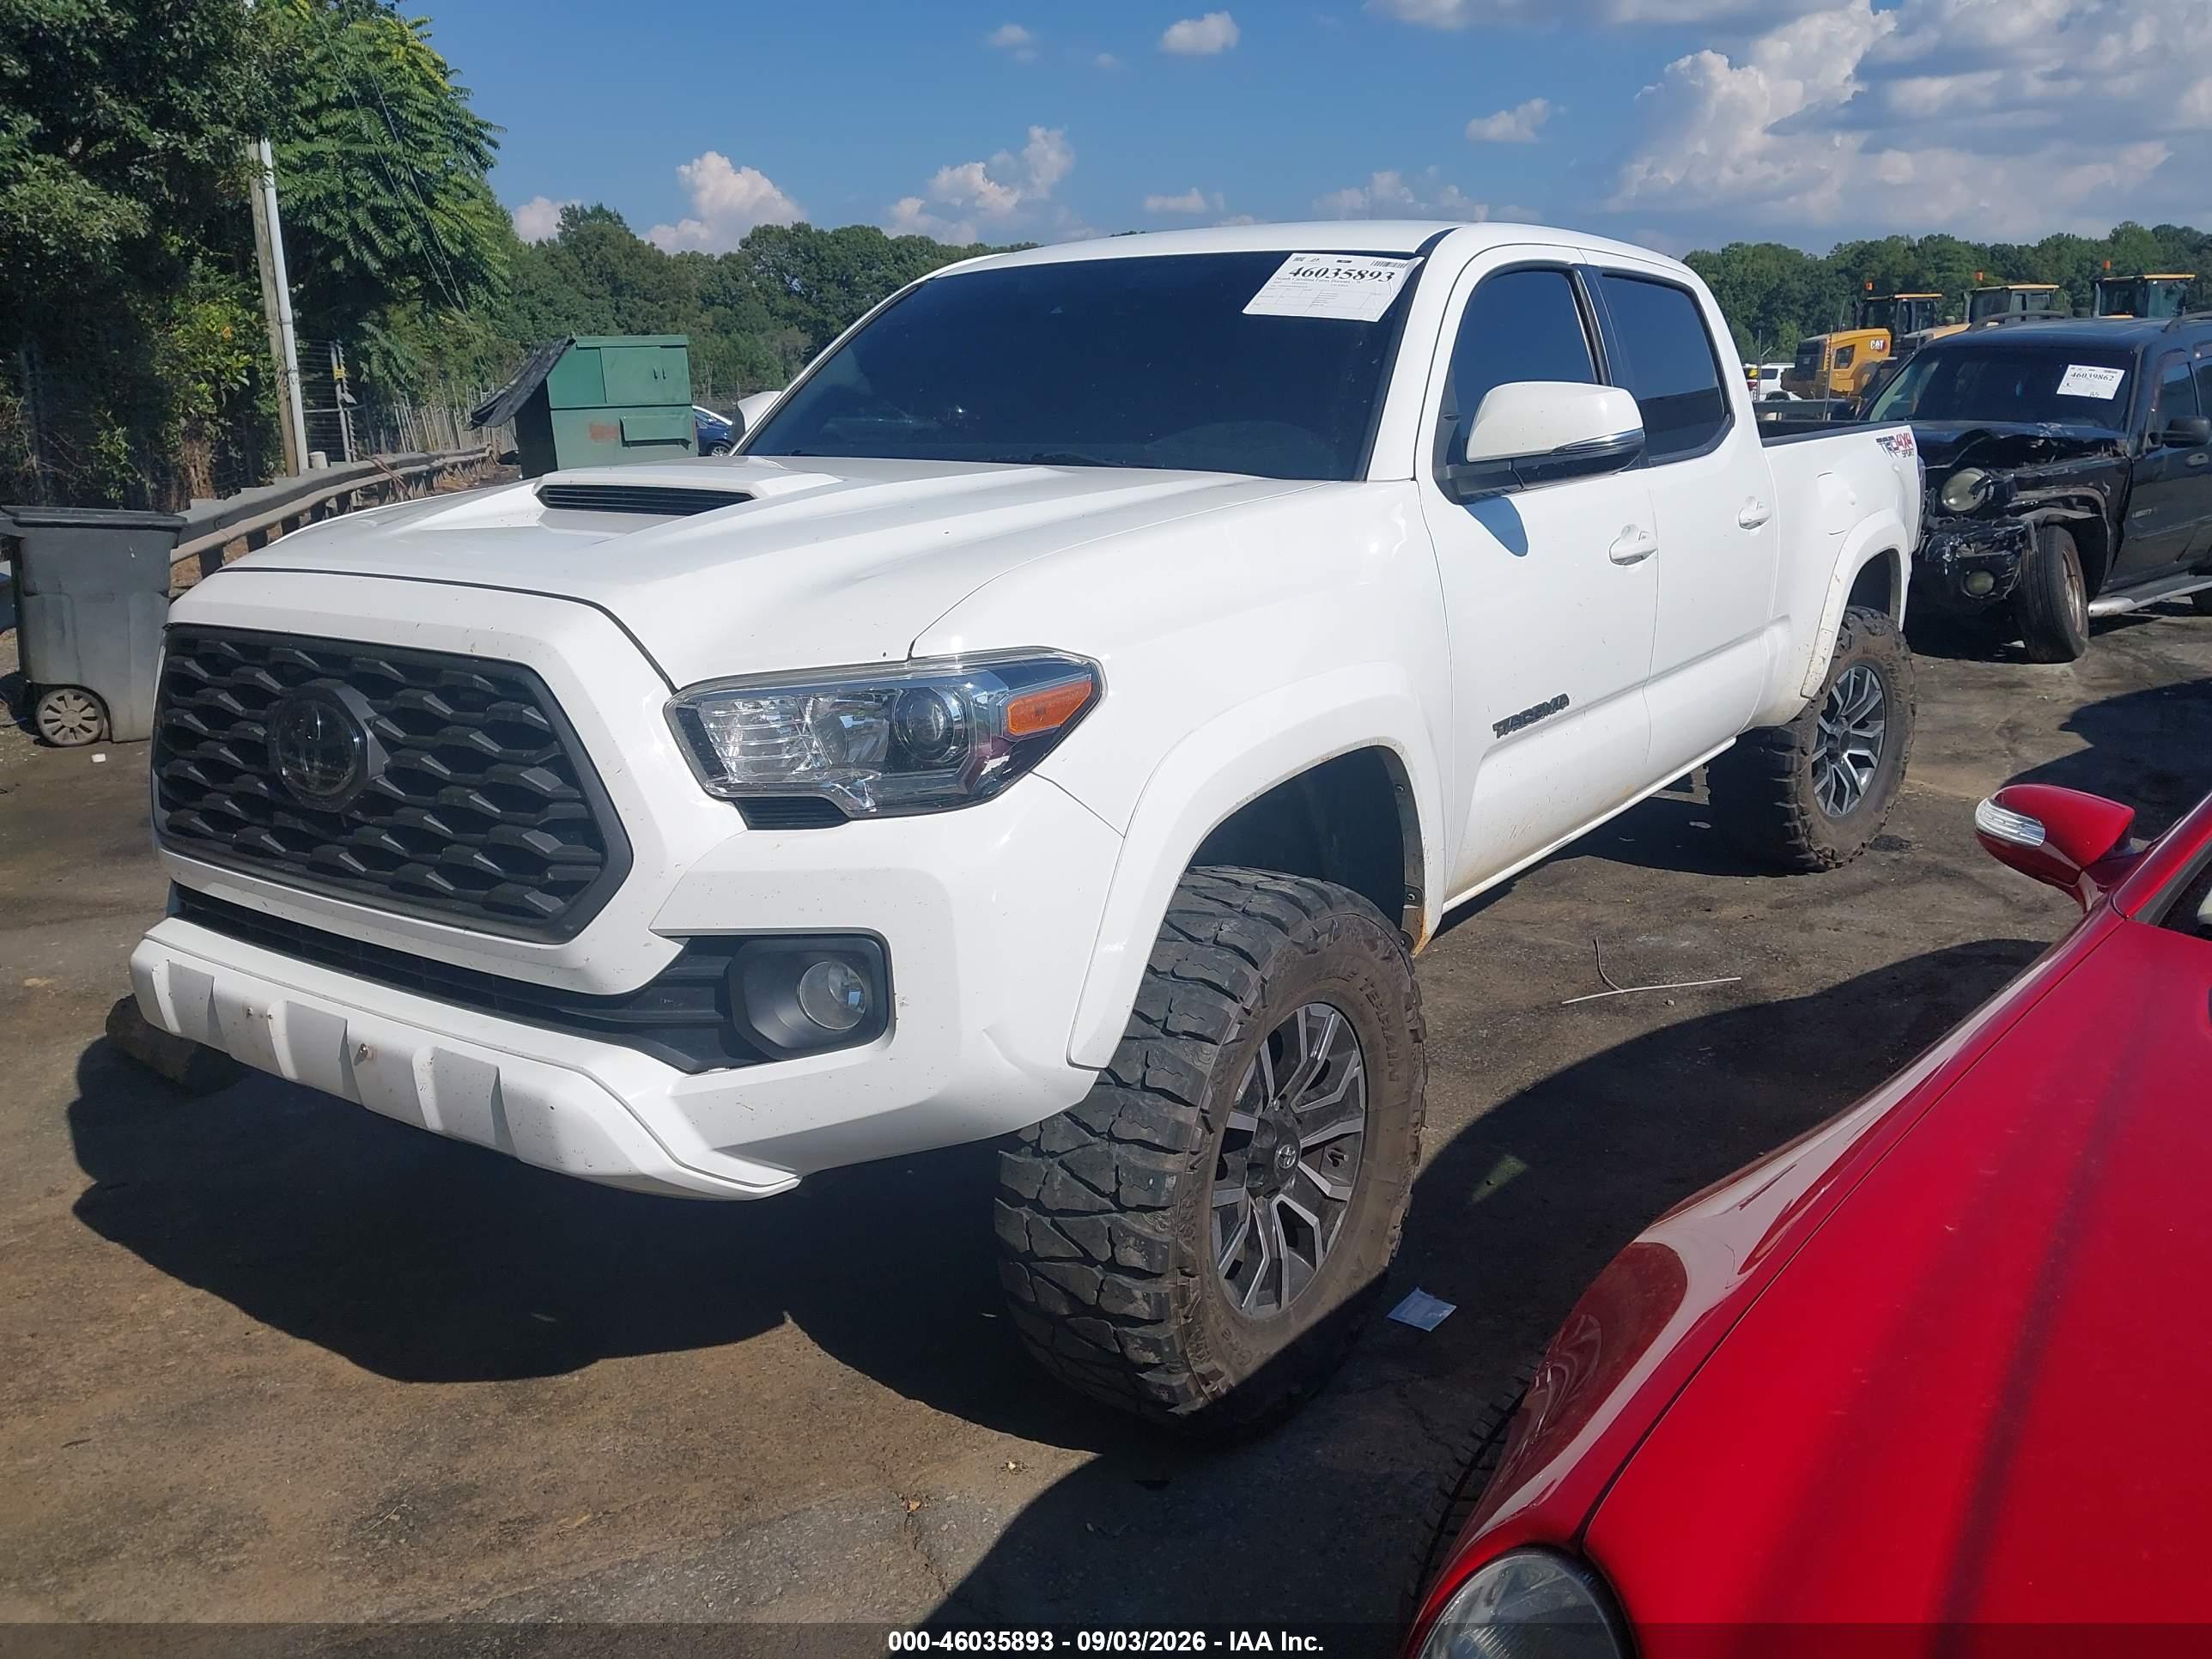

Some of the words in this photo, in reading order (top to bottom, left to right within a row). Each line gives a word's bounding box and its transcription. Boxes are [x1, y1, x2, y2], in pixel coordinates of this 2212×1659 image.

[1289, 266, 1395, 283] 46035893
[1870, 339, 1884, 350] CAT
[1875, 435, 1899, 459] TRD
[1492, 693, 1570, 739] TACOMA
